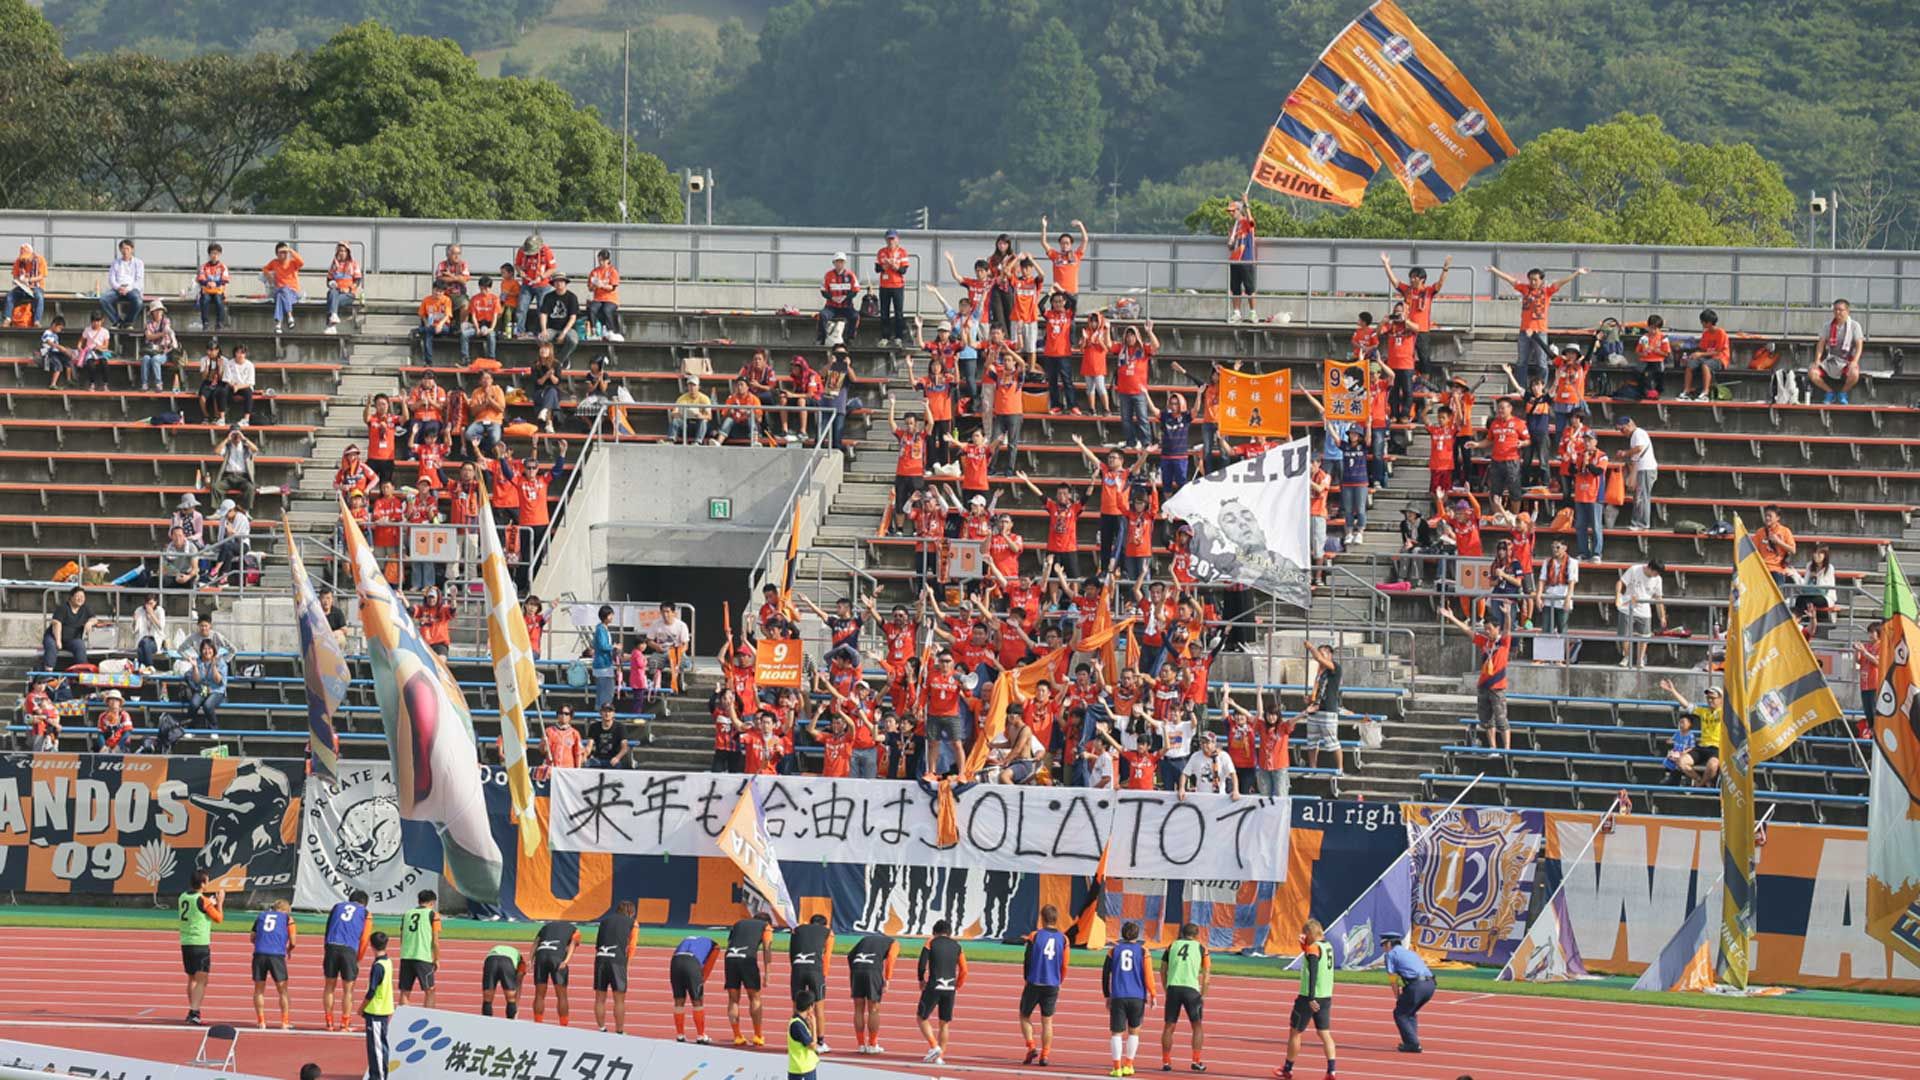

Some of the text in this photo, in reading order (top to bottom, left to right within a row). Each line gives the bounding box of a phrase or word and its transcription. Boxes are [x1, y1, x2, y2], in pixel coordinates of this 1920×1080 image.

[1256, 160, 1333, 200] EHIME
[1330, 368, 1341, 388] 9
[773, 643, 788, 663] 9
[1302, 802, 1334, 824] all
[306, 833, 354, 897] RANCIO
[1436, 851, 1488, 904] 12
[181, 900, 189, 921] 2
[340, 904, 356, 922] 3
[263, 914, 277, 932] 5
[408, 913, 421, 932] 3
[1043, 937, 1056, 960] 4
[1177, 943, 1189, 962] 4
[1326, 947, 1333, 970] 5
[1121, 949, 1133, 971] 6
